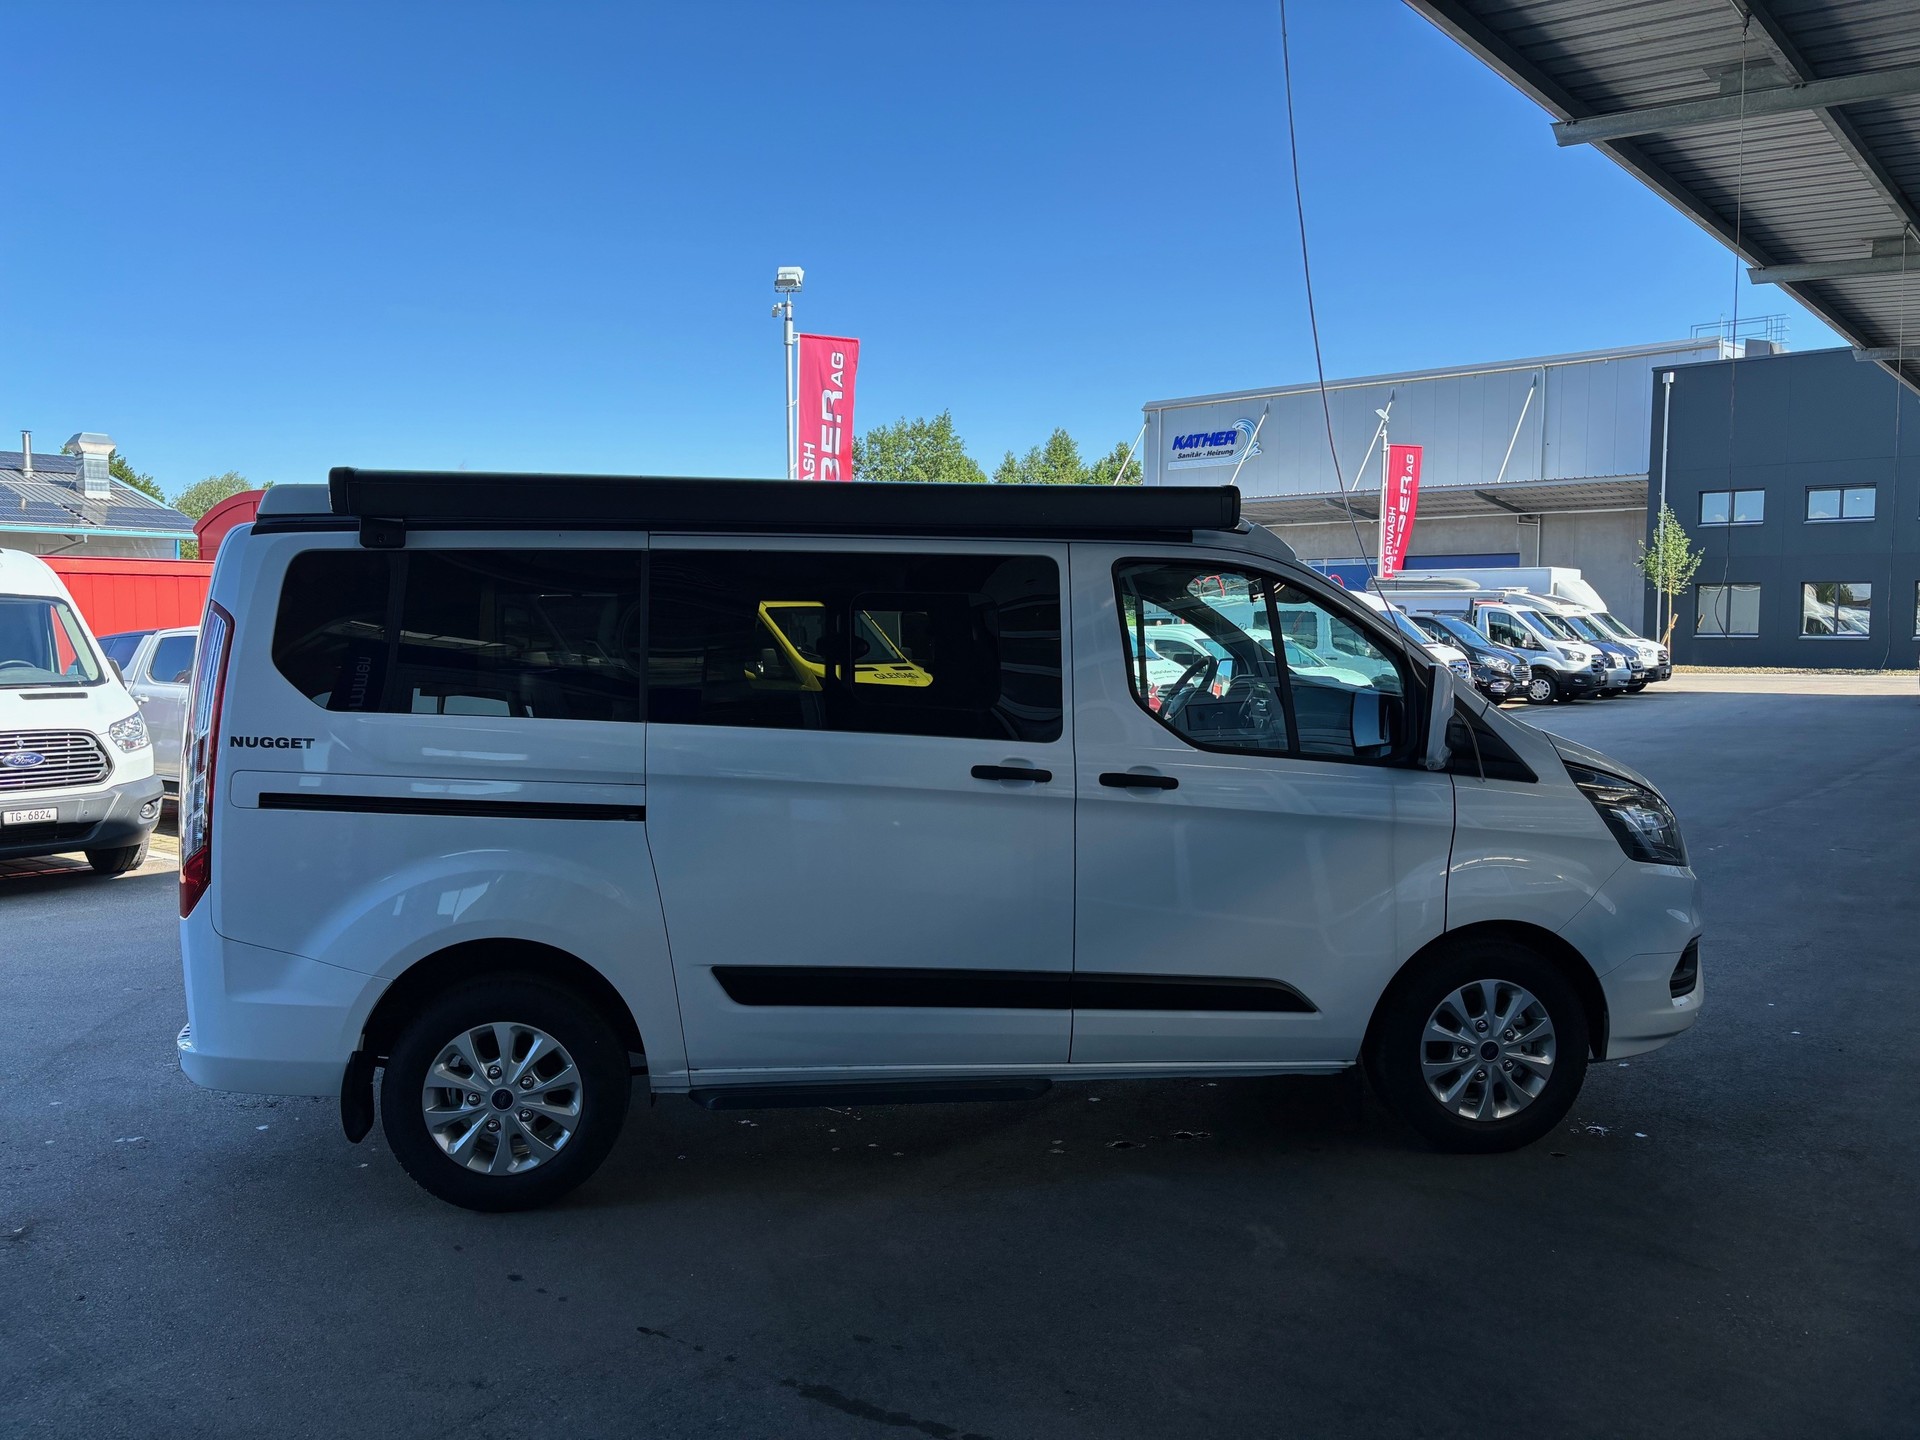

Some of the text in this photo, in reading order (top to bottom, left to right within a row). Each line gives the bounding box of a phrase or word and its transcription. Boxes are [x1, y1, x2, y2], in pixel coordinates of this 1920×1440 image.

[831, 352, 844, 387] AG
[1172, 431, 1238, 450] KATHER
[1206, 449, 1234, 457] Heizung
[1406, 454, 1414, 474] AG
[230, 736, 315, 749] NUGGET
[14, 755, 36, 764] Ford
